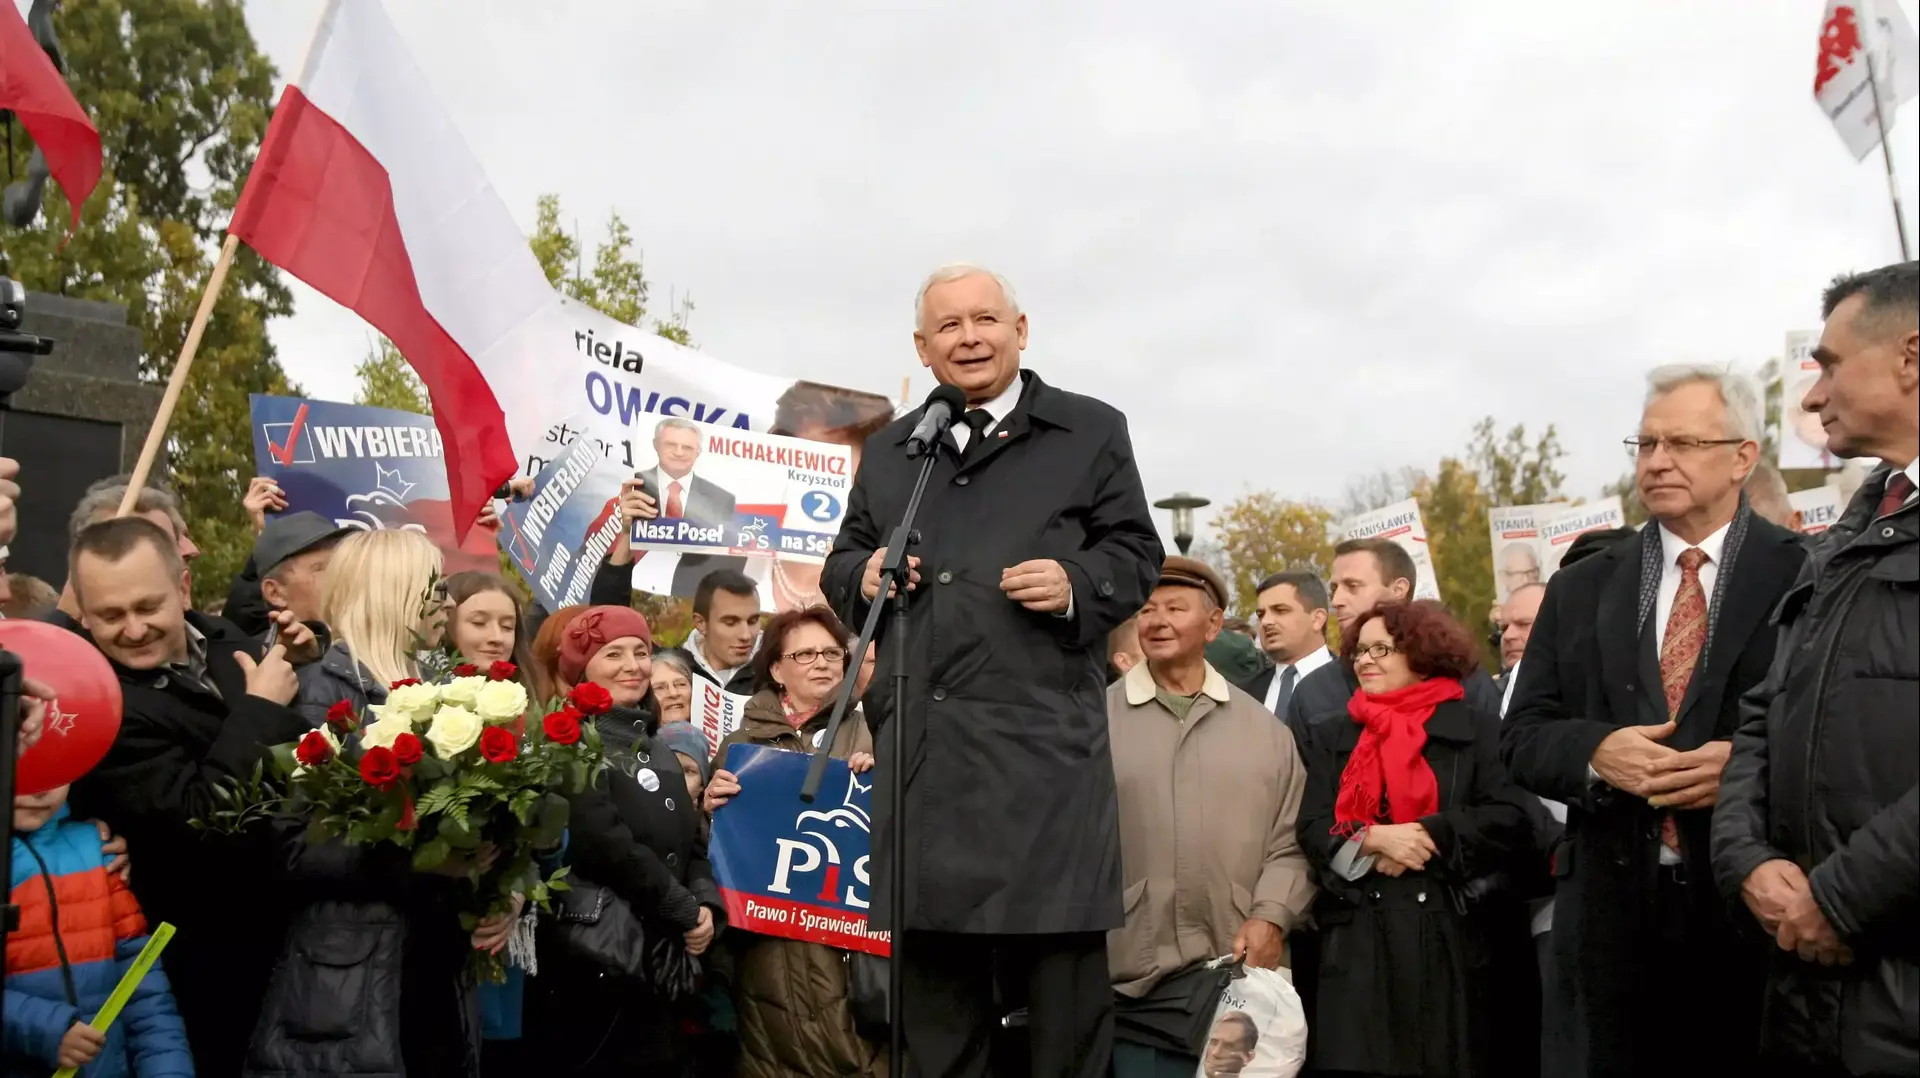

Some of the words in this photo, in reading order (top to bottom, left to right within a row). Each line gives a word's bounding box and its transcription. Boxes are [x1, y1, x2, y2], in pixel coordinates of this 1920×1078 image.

[708, 435, 847, 476] MICHAŁKIEWICZ
[521, 438, 599, 547] WYBIERAM
[787, 469, 847, 489] Krzysztof
[812, 493, 831, 519] 2
[635, 520, 675, 540] Nasz
[677, 521, 724, 543] Poseł
[1348, 511, 1416, 540] STANISŁAWEK
[1541, 509, 1618, 538] STANISŁAWEK
[781, 535, 803, 551] na
[540, 542, 571, 600] Prawo
[746, 900, 788, 922] Prawo
[791, 908, 797, 924] i
